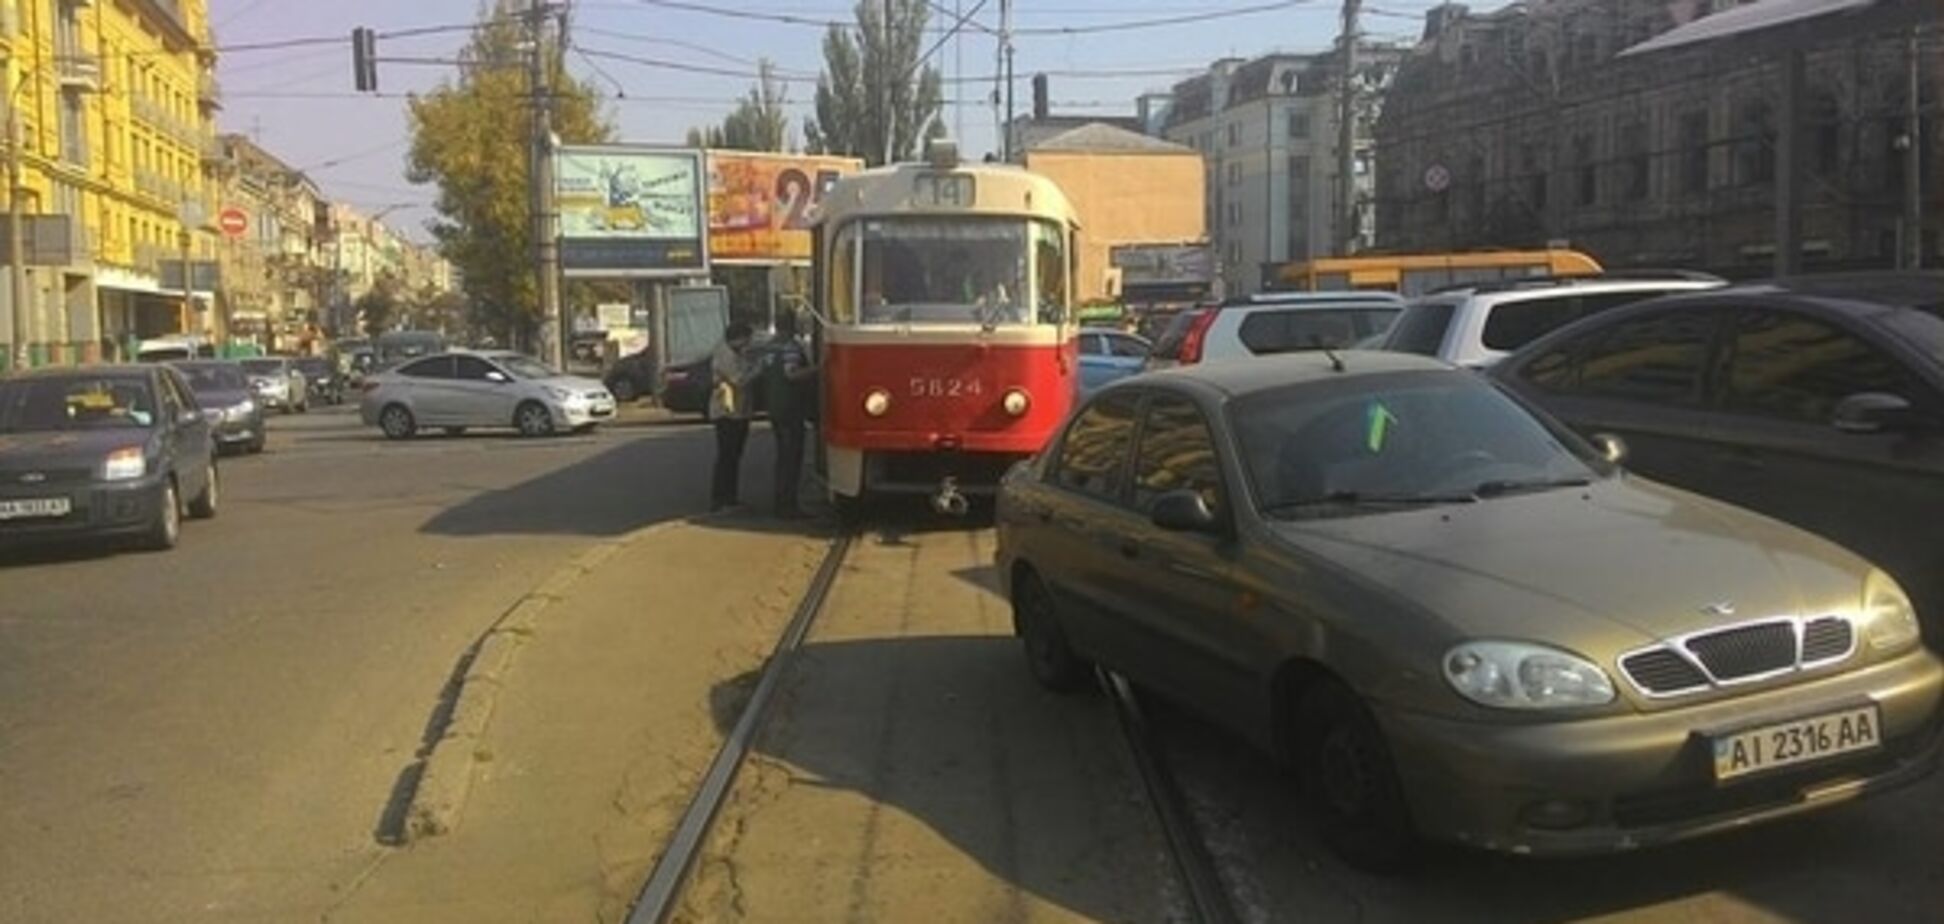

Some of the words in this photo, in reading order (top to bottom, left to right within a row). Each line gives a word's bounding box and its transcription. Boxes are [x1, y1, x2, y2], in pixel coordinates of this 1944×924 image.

[931, 175, 960, 206] 14
[909, 377, 982, 397] 5824
[1731, 738, 1761, 770] AI
[1773, 723, 1832, 760] 2316
[1838, 713, 1872, 748] AA
